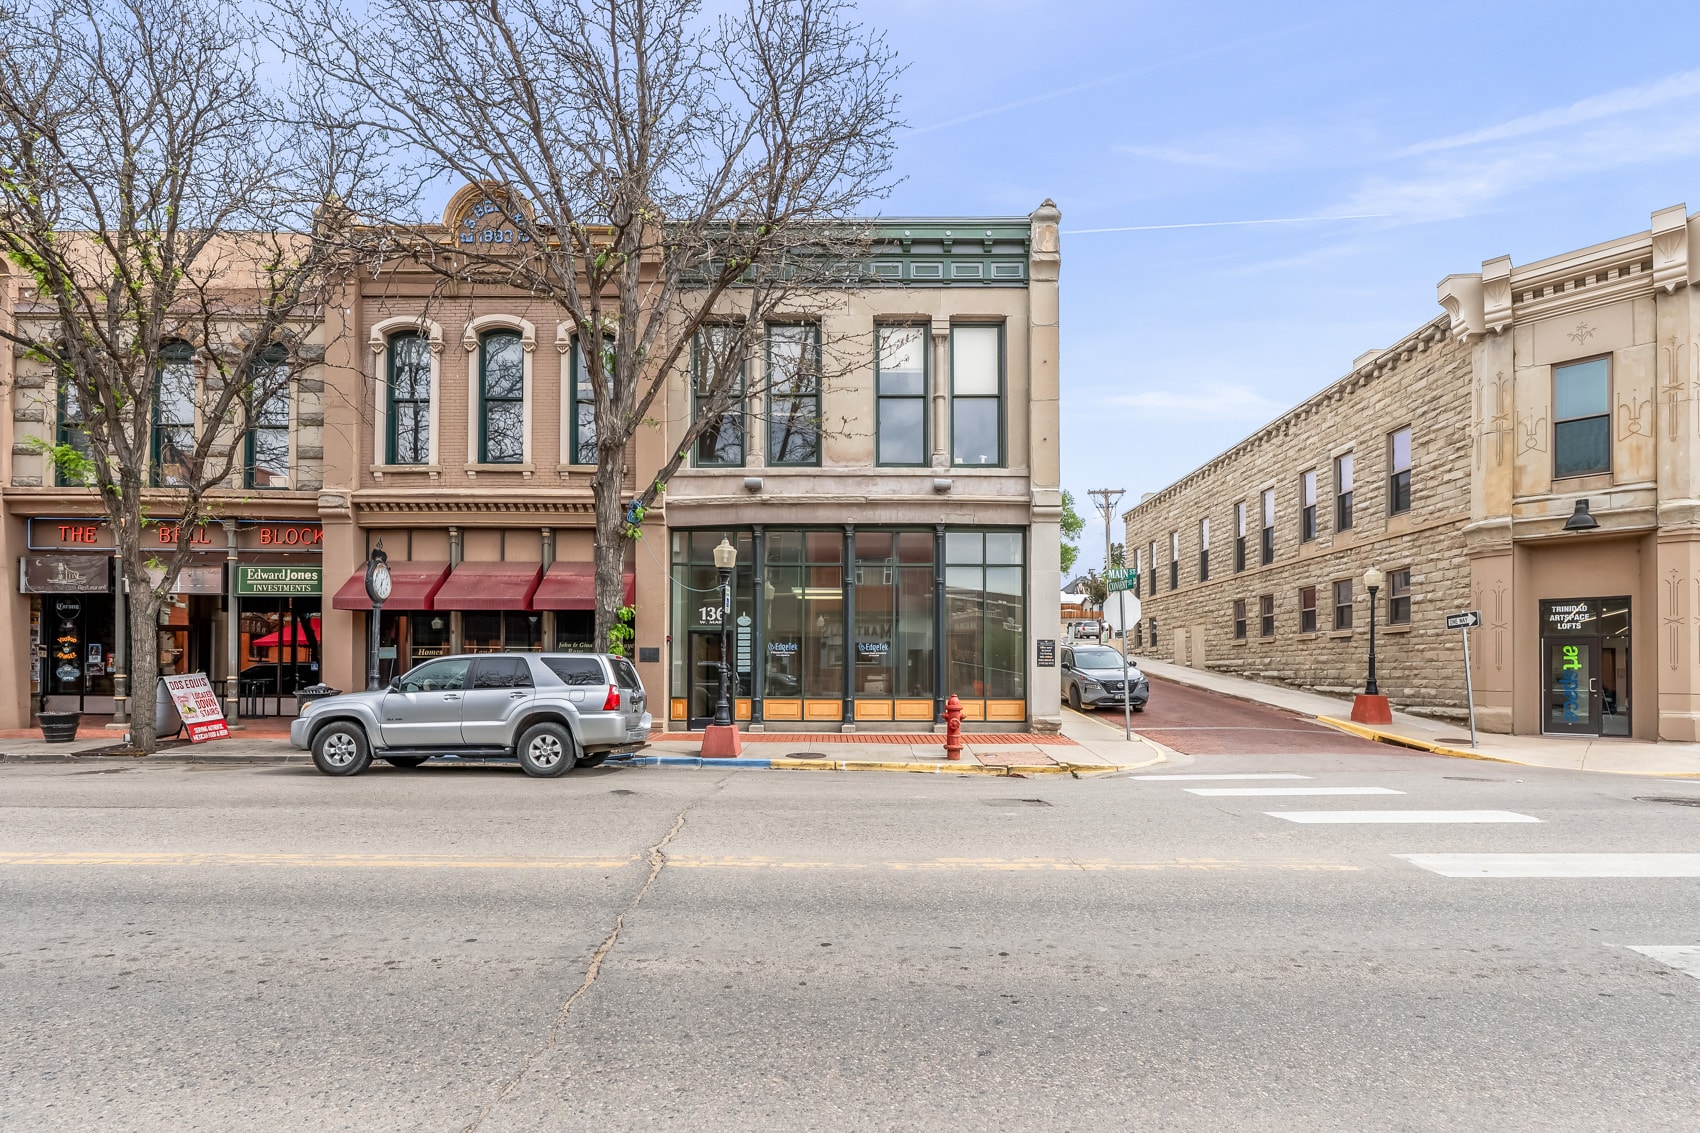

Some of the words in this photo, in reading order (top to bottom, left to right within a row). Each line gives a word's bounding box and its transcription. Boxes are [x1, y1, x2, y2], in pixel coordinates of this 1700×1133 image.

[58, 526, 97, 543] THE
[260, 528, 323, 545] BLOCK
[1108, 569, 1128, 579] MAIN
[253, 584, 311, 592] INVESTMENTS
[699, 606, 723, 620] 136
[1549, 613, 1590, 621] ARTSPACE
[775, 642, 798, 651] EdgeTek
[865, 643, 888, 652] EdgeTek
[418, 648, 444, 656] Homes
[169, 680, 184, 690] DOS
[185, 677, 207, 689] EQUIS
[195, 698, 217, 709] DOWN
[200, 707, 220, 717] STAIRS
